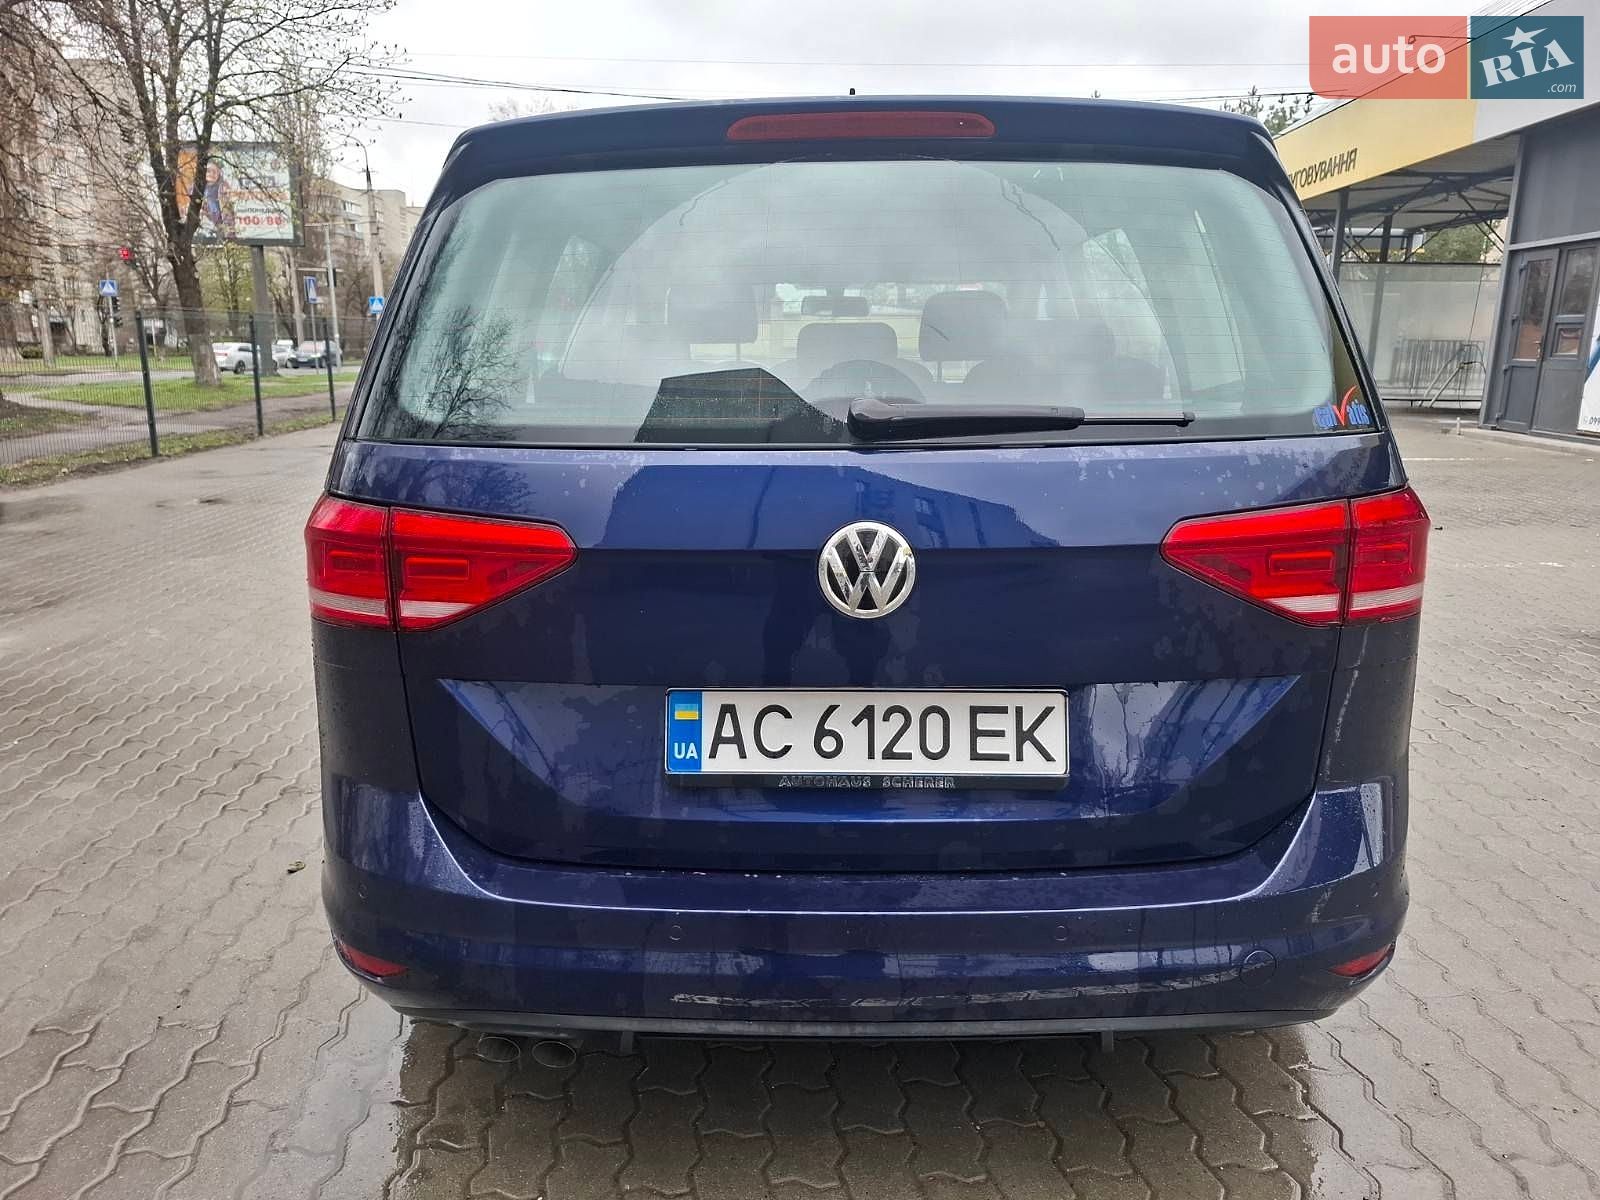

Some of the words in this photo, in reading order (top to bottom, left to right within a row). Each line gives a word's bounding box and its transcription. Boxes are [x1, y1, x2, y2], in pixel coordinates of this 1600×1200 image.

[708, 703, 793, 760] AC
[813, 704, 951, 760] 6120
[969, 705, 1057, 762] EK
[673, 742, 699, 760] UA
[778, 775, 871, 788] AUTOHAUS
[882, 776, 956, 789] SCHERER
